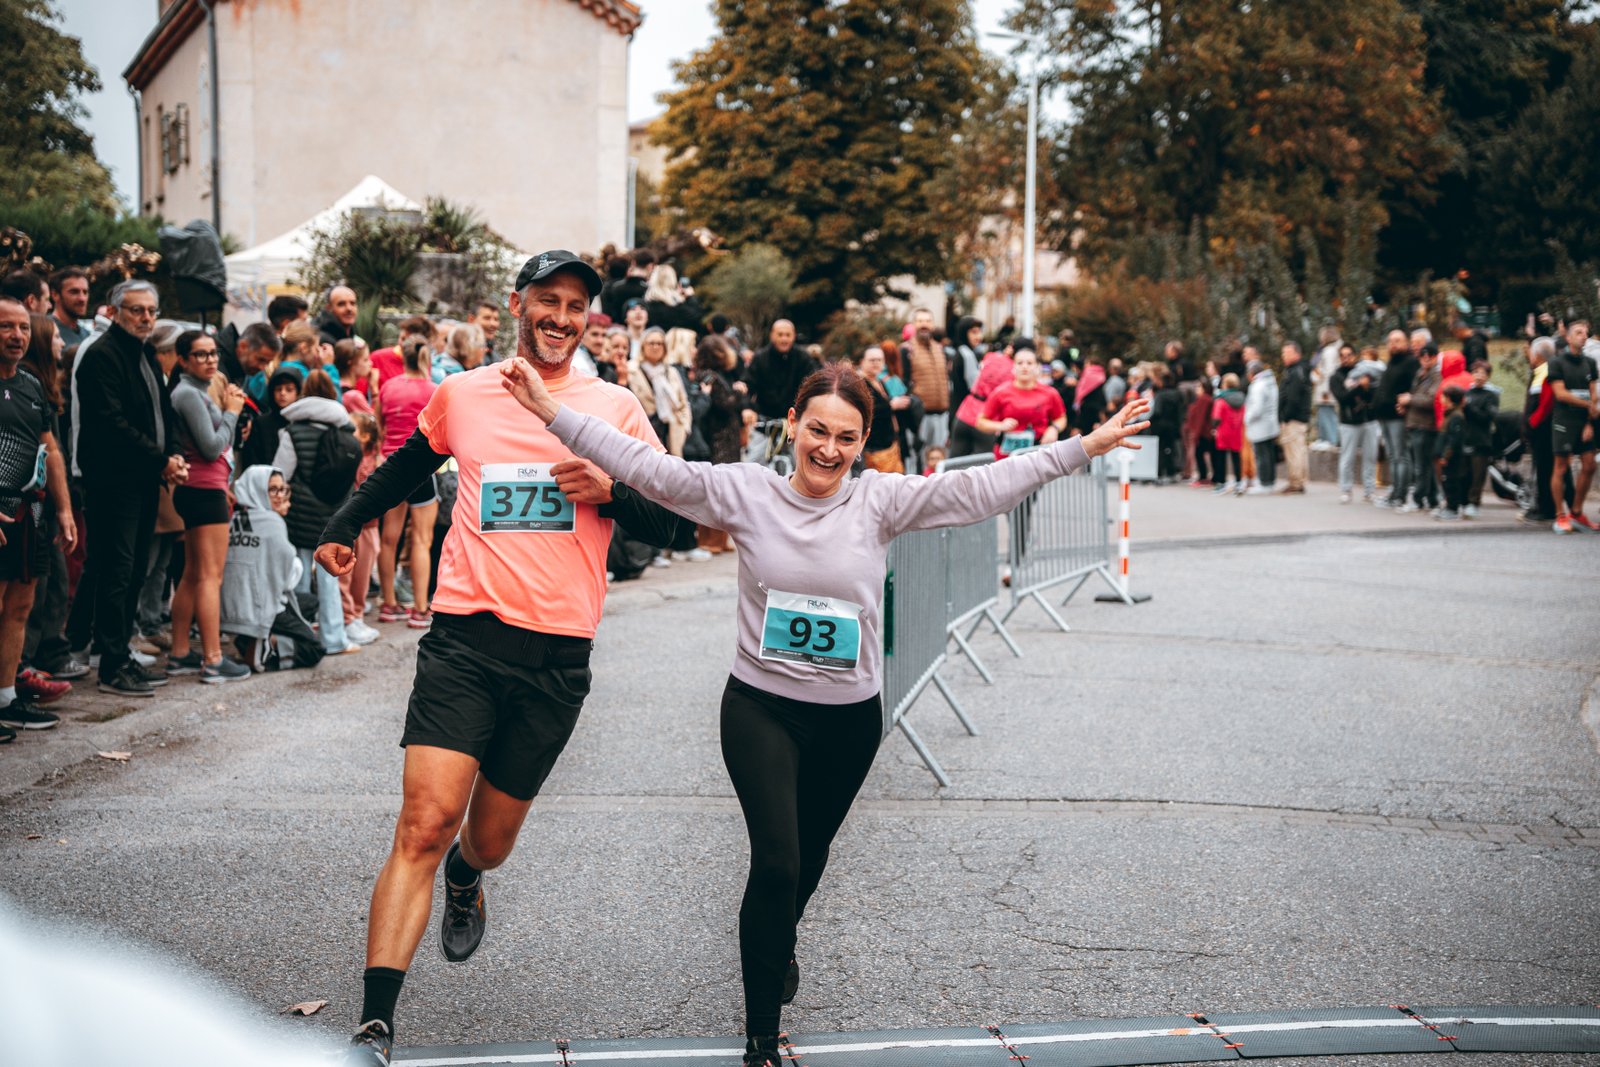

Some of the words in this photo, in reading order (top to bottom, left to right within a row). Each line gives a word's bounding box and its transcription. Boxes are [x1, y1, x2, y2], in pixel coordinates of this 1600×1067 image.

[518, 468, 537, 476] RUN
[491, 486, 562, 517] 375
[808, 600, 828, 608] RUN
[789, 617, 836, 652] 93
